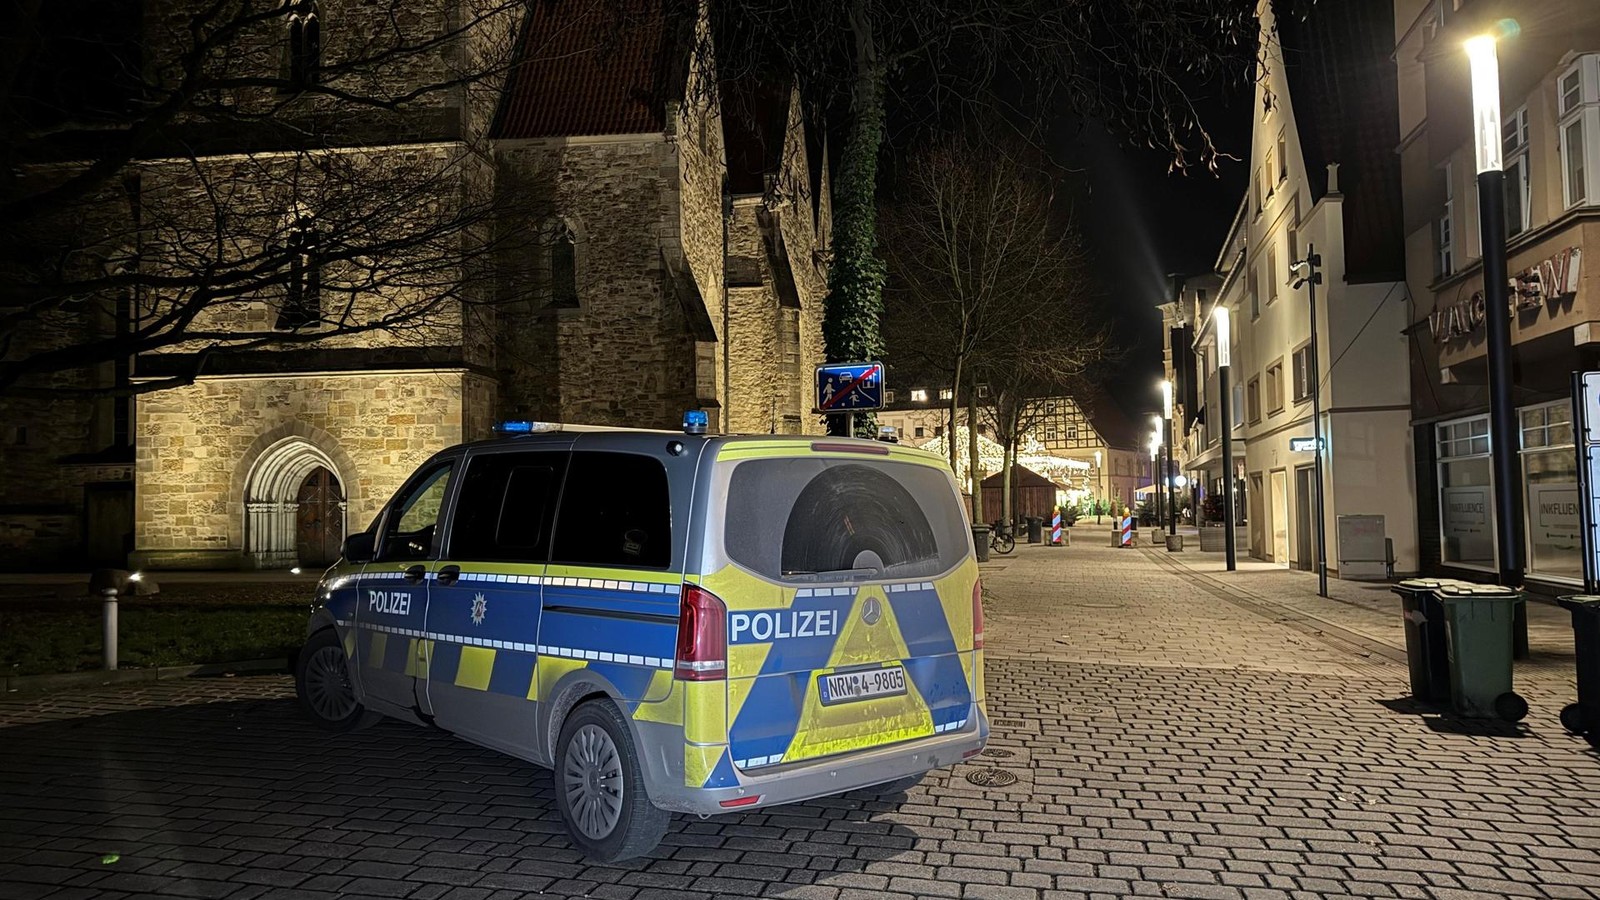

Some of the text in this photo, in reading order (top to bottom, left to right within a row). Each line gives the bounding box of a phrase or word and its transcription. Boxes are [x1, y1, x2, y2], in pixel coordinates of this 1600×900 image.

[369, 590, 411, 615] POLIZEI
[731, 609, 838, 642] POLIZEI
[829, 676, 854, 698] NRW
[861, 670, 904, 693] 4-9805
